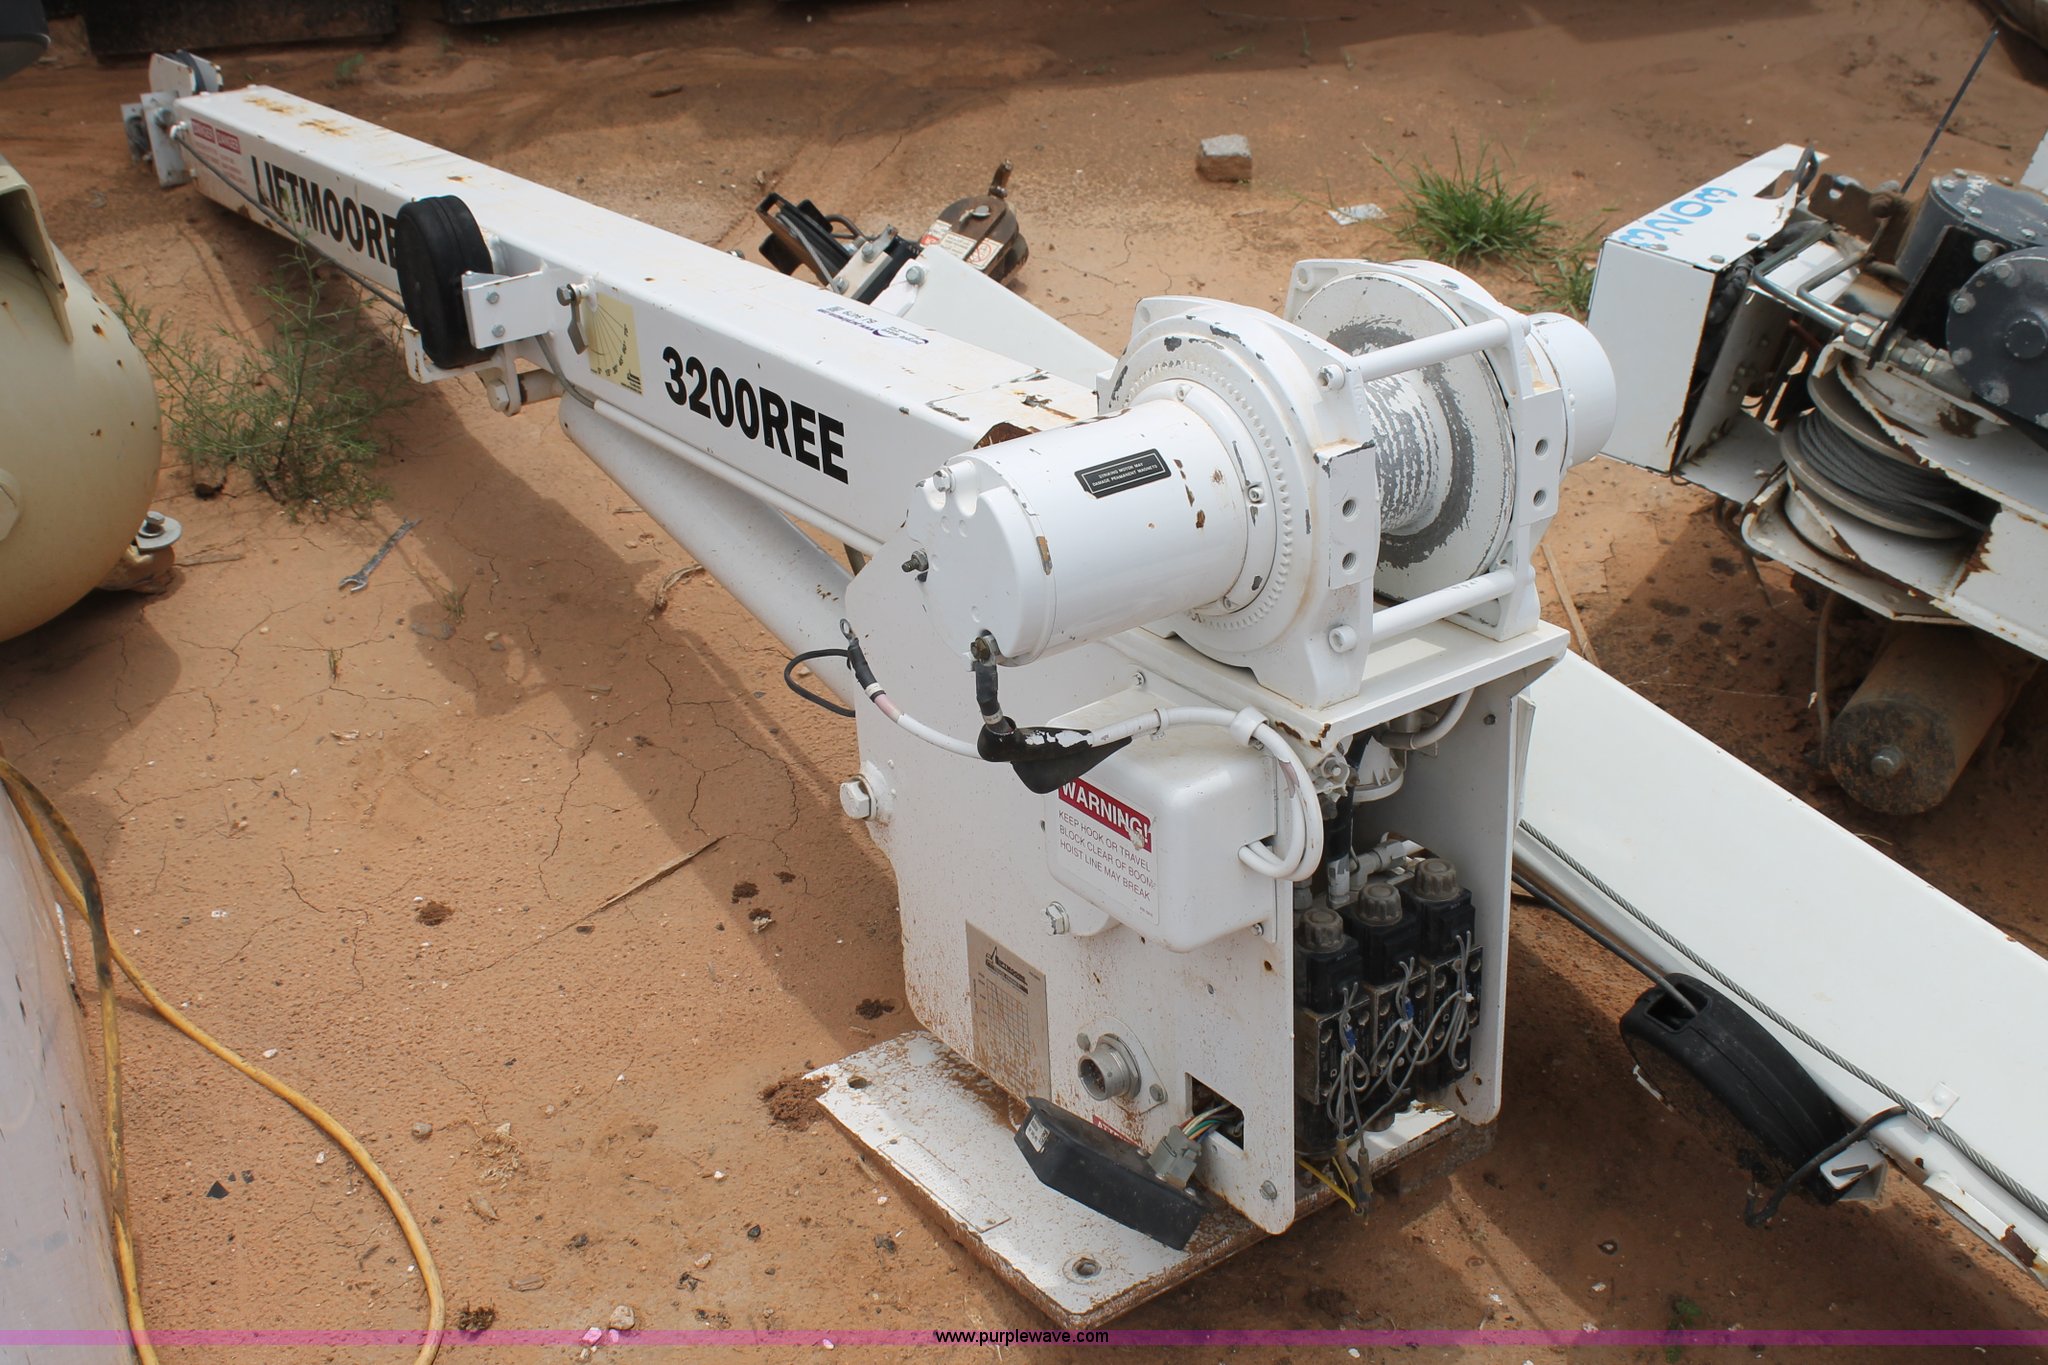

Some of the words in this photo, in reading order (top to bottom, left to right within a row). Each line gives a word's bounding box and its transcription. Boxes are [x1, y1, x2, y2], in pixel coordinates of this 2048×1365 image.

[662, 346, 849, 485] 3200REE
[1091, 478, 1110, 487] DAMAGE
[1110, 470, 1137, 481] PERMANENT
[1118, 465, 1135, 474] MOTOR
[1134, 462, 1144, 470] MAY
[1059, 810, 1080, 827] KEEP
[1081, 823, 1103, 844] HOOK
[1105, 838, 1118, 852] OR
[1120, 845, 1151, 873] TRAVEL
[1062, 781, 1148, 844] WARNING!
[1060, 824, 1085, 847] BLOCK
[1087, 842, 1113, 865] CLEAR
[1115, 858, 1127, 871] OF
[1060, 839, 1083, 860] HOIST
[1085, 854, 1102, 872] LINE
[1104, 866, 1121, 882] MAY
[1123, 878, 1151, 901] BREAK
